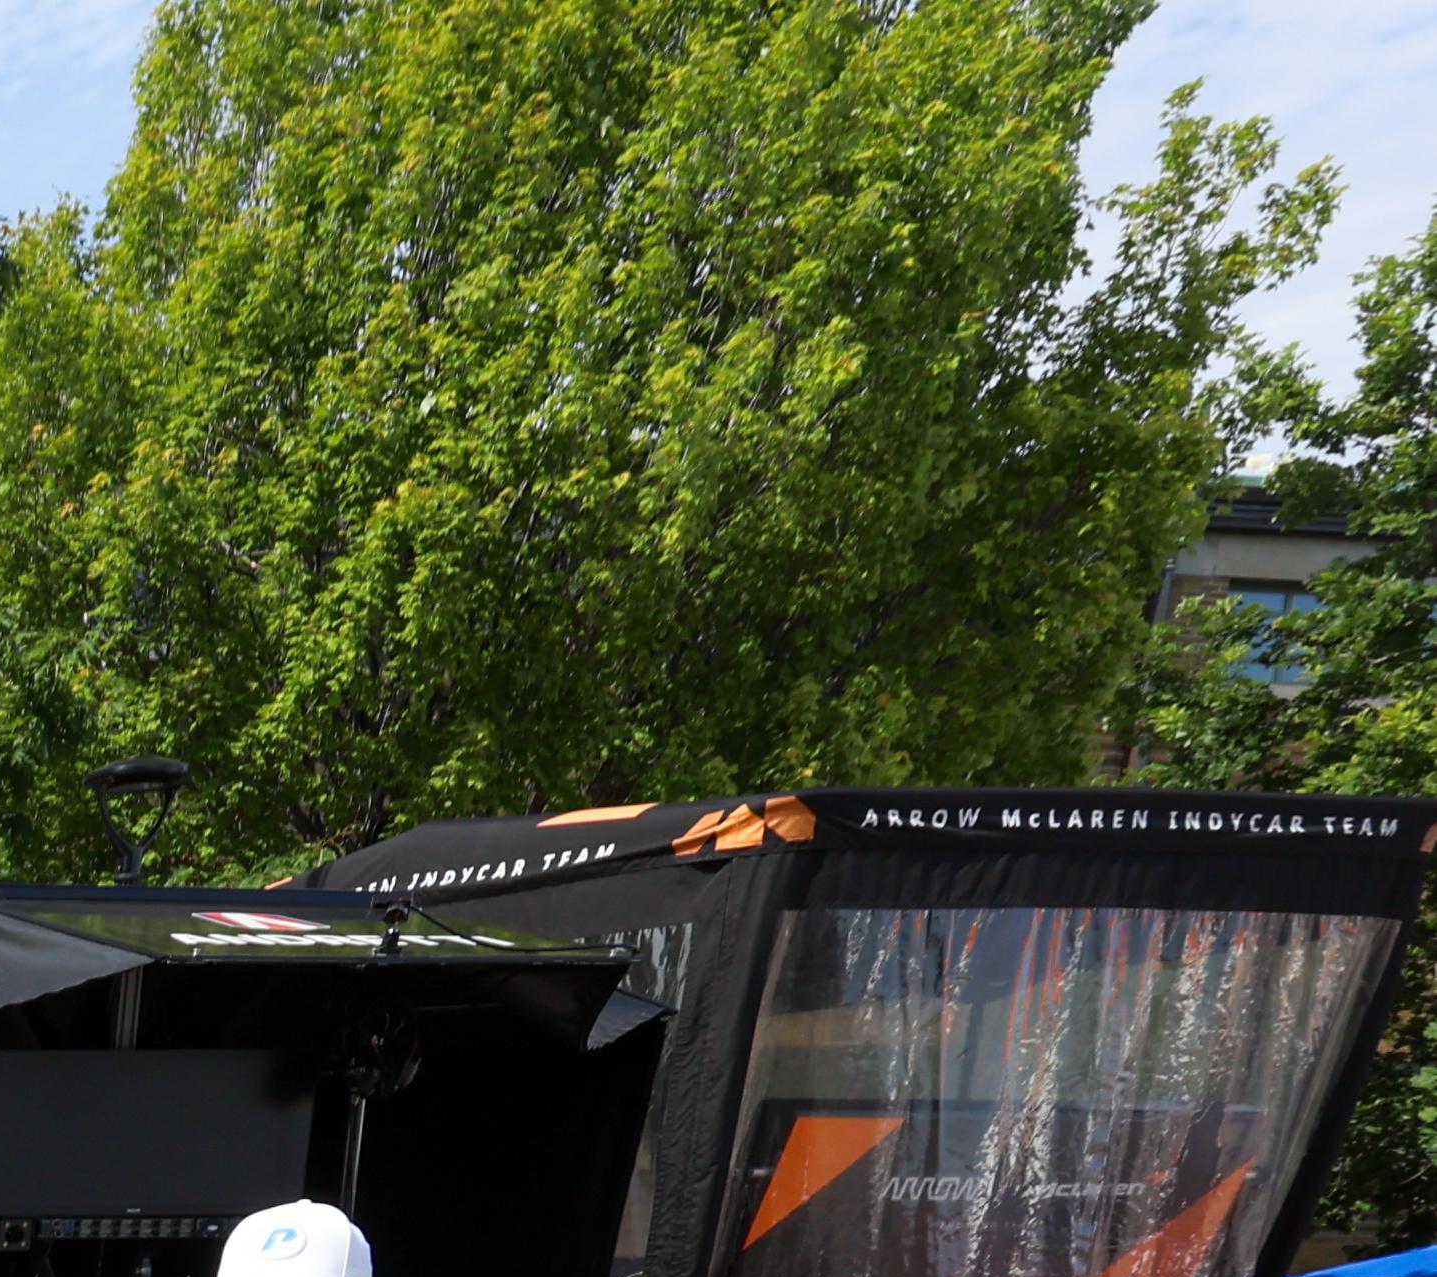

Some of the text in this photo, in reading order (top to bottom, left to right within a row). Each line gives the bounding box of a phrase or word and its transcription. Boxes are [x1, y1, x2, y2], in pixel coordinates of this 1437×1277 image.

[862, 808, 1400, 838] ARROW McLAREN INDYCAR TEAM
[410, 858, 526, 892] INDYCAR
[541, 842, 617, 870] TEAM
